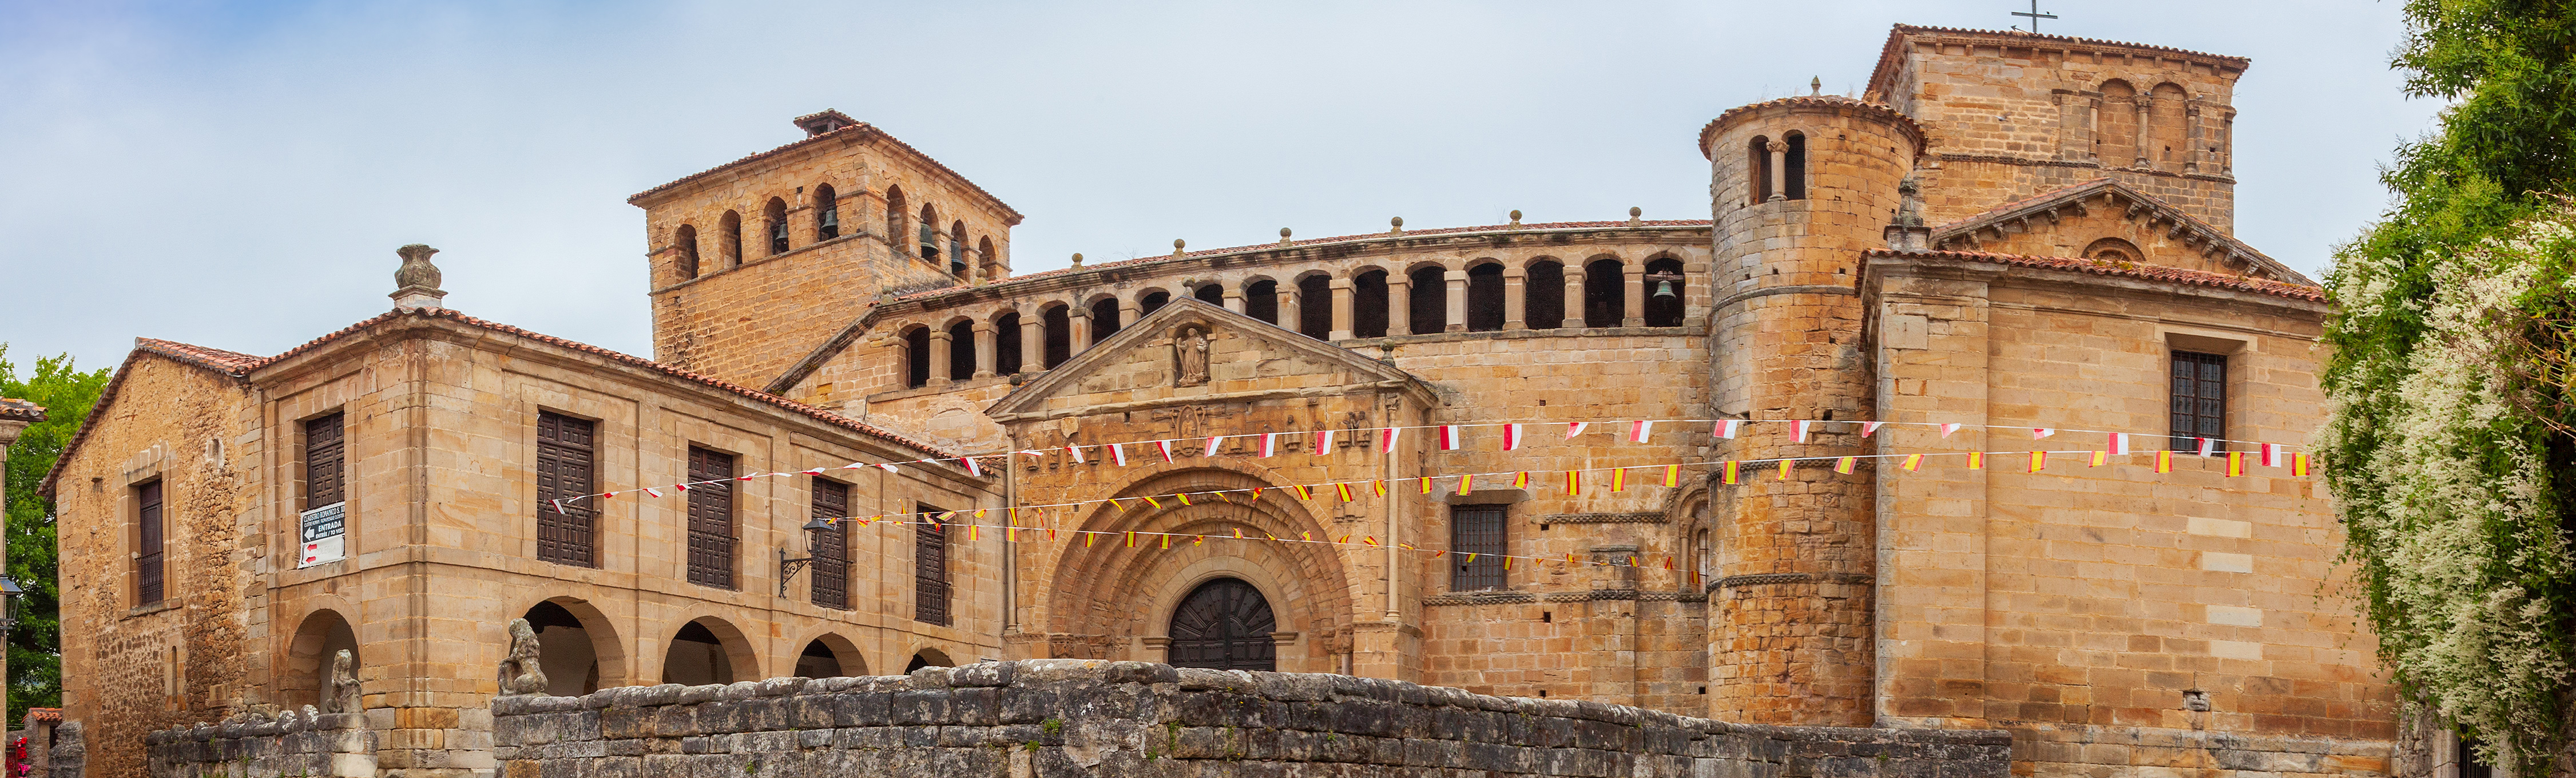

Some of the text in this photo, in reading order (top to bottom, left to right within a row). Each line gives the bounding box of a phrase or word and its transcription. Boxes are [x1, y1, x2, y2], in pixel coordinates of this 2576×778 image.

[304, 513, 319, 522] CLAUSTRO
[318, 521, 342, 532] ENTRADA
[316, 531, 327, 539] ENTRÉE
